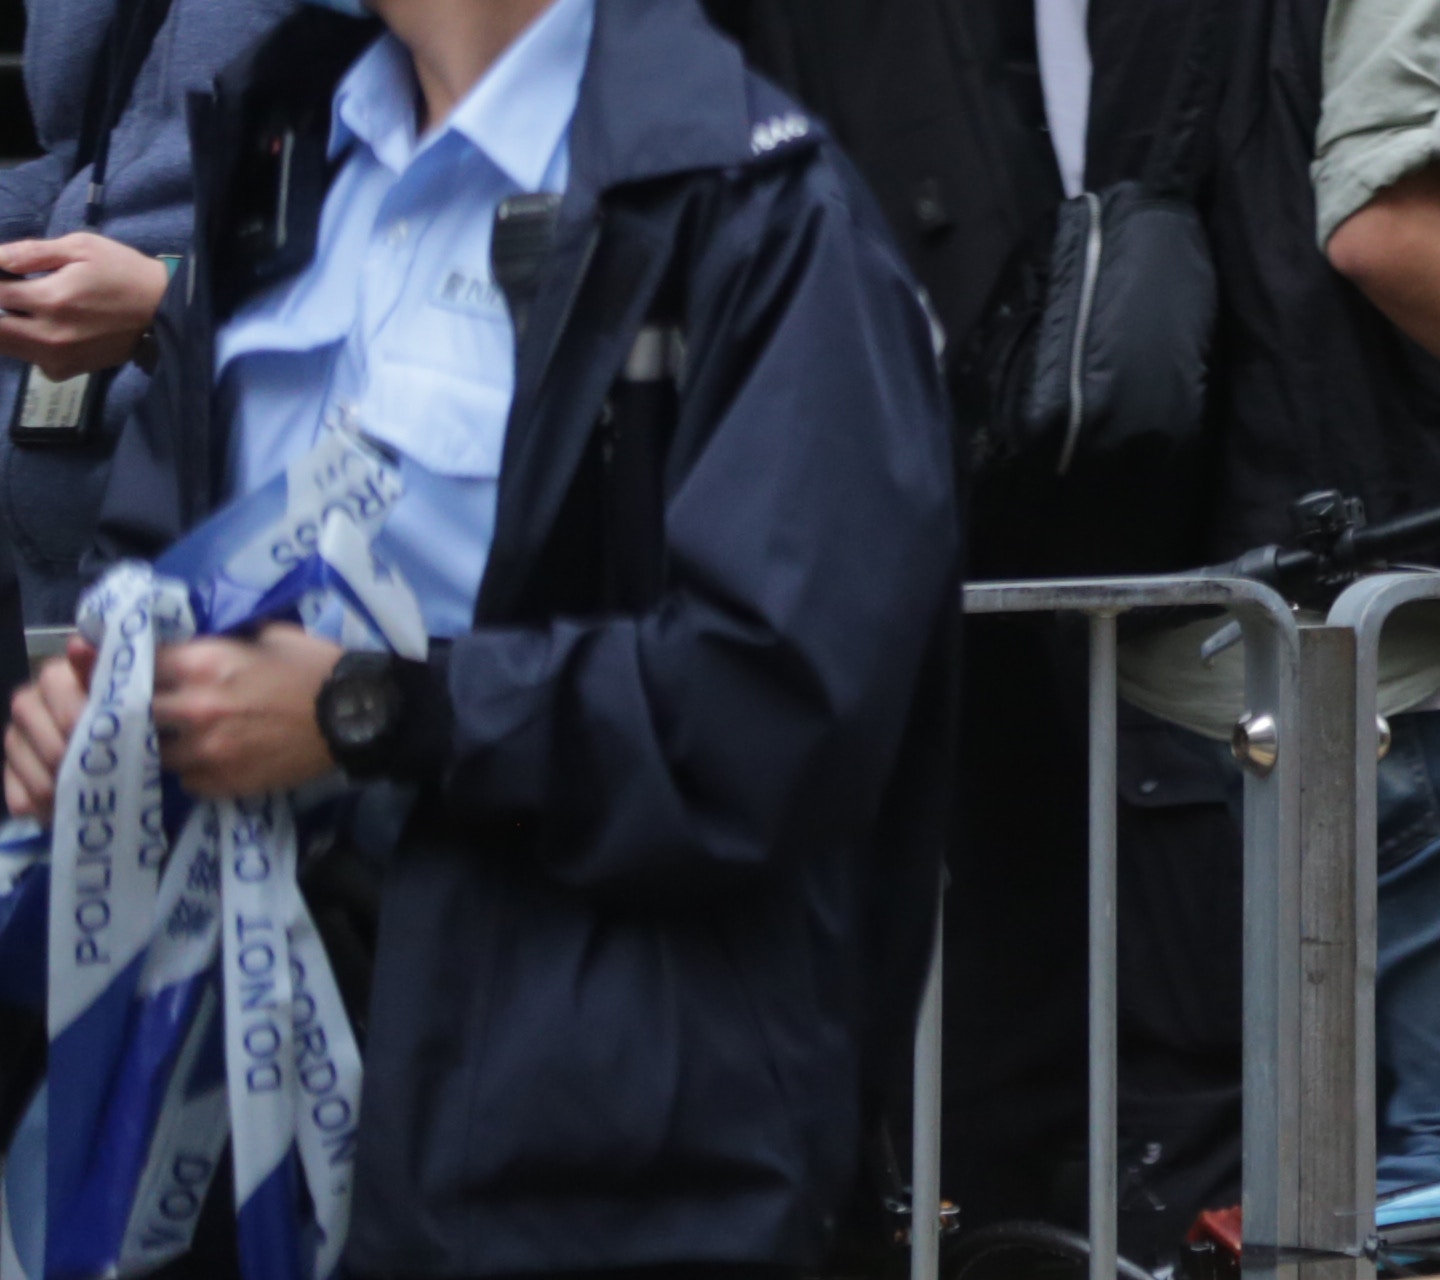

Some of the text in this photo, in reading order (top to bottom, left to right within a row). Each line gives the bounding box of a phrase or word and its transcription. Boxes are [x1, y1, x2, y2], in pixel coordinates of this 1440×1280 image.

[76, 788, 118, 967] POLICE
[237, 912, 276, 1012] NOT
[242, 1020, 282, 1094] DO
